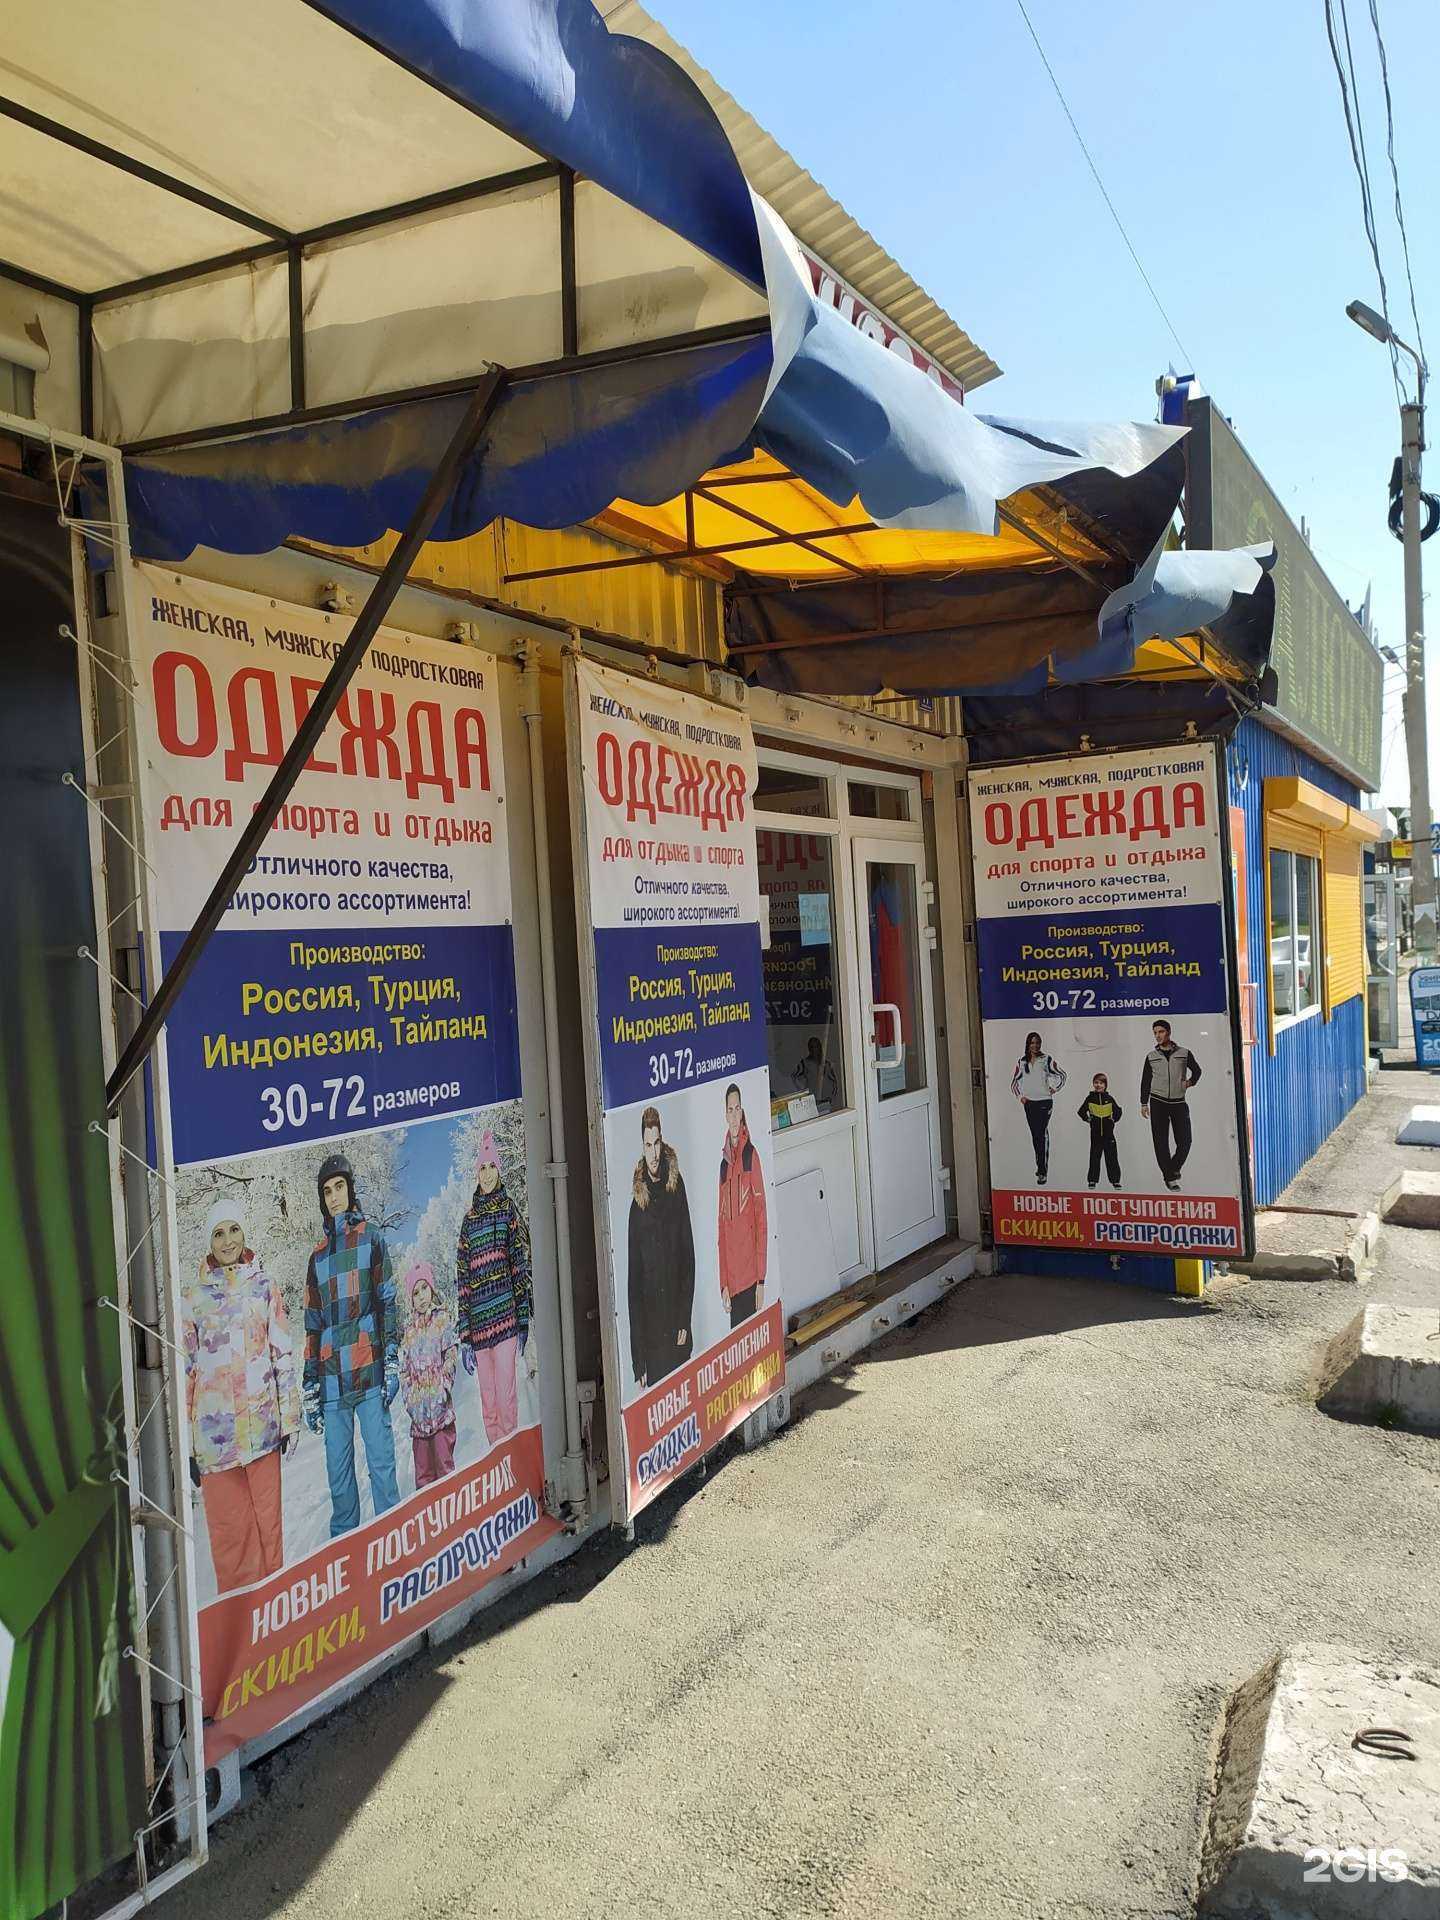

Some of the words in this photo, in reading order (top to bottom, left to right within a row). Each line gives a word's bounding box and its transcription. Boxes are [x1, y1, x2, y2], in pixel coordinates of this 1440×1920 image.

[151, 597, 255, 647] ЖЕНСКАЯ,
[264, 626, 363, 669] МУЖСКА,
[371, 649, 484, 691] ПОДРОСТКОВАЯ
[685, 723, 742, 751] ПОДРОСТКОВАЯ
[597, 732, 746, 832] ОДЕЖДА
[977, 781, 1033, 796] ЖЕНСКАЯ,
[1039, 773, 1101, 789] МУЖСКАЯ,
[1108, 760, 1204, 782] ПОДРОСТКОВАЯ
[160, 795, 233, 832] для
[252, 801, 359, 839] порта
[375, 812, 391, 837] и
[404, 814, 493, 846] отдыха
[984, 782, 1206, 851] ОДЕЖДА
[603, 837, 633, 862] для
[638, 840, 690, 865] отдыха
[708, 846, 744, 869] спорта
[987, 862, 1021, 879] для
[1030, 856, 1095, 874] спорта
[1105, 854, 1116, 867] и
[1128, 846, 1206, 867] отдыха
[368, 859, 454, 883] качества,
[634, 875, 688, 895] Отличного
[692, 882, 730, 897] качества,
[1020, 879, 1096, 893] Отличного
[1100, 872, 1170, 887] качества,
[337, 890, 472, 915] ассортимента!
[623, 906, 675, 925] широкого
[678, 903, 741, 923] ассортимента!
[1007, 896, 1074, 912] широкого
[1079, 886, 1187, 907] ассортимента!
[1048, 923, 1145, 939] Производство:
[290, 942, 426, 970] Производство:
[657, 944, 719, 965] Производство:
[1022, 945, 1094, 960] Россия,
[1098, 941, 1175, 959] Турция,
[629, 975, 685, 1001] Россия,
[688, 969, 736, 999] Турция,
[1002, 965, 1110, 983] Индонезия,
[1115, 959, 1201, 977] Тайланд
[242, 982, 360, 1016] Россия,
[368, 975, 461, 1012] Турция,
[1032, 989, 1097, 1011] 30-72
[1101, 996, 1170, 1011] размеров
[612, 1010, 698, 1044] Индонезия,
[700, 1001, 750, 1027] Тайланд
[203, 1025, 384, 1069] Индонезия,
[390, 1014, 487, 1046] Тайланд
[649, 1047, 694, 1087] 30-72
[696, 1053, 736, 1079] размеров
[260, 1075, 367, 1132] 30-72
[373, 1080, 461, 1117] размеров
[1014, 1195, 1072, 1213] НОВЫЕ
[1083, 1197, 1217, 1219] ПОСТУПЛЕНИЯ
[1000, 1218, 1085, 1242] СКИДКИ,
[1096, 1221, 1237, 1247] РАСПРОДАЖИ
[648, 1379, 692, 1436] НОВЫЕ
[696, 1321, 770, 1397] ПОСТУПЛЕНИЯ
[637, 1412, 701, 1486] СКИДКИ,
[705, 1350, 781, 1430] РАСПРОДАЖИ
[252, 1555, 350, 1645] НОВЫЕ
[367, 1454, 518, 1576] ПОСТУПЛЕНИЯ
[221, 1605, 368, 1719] СКИДКИ,
[381, 1493, 538, 1623] РАСПРОДАЖИ
